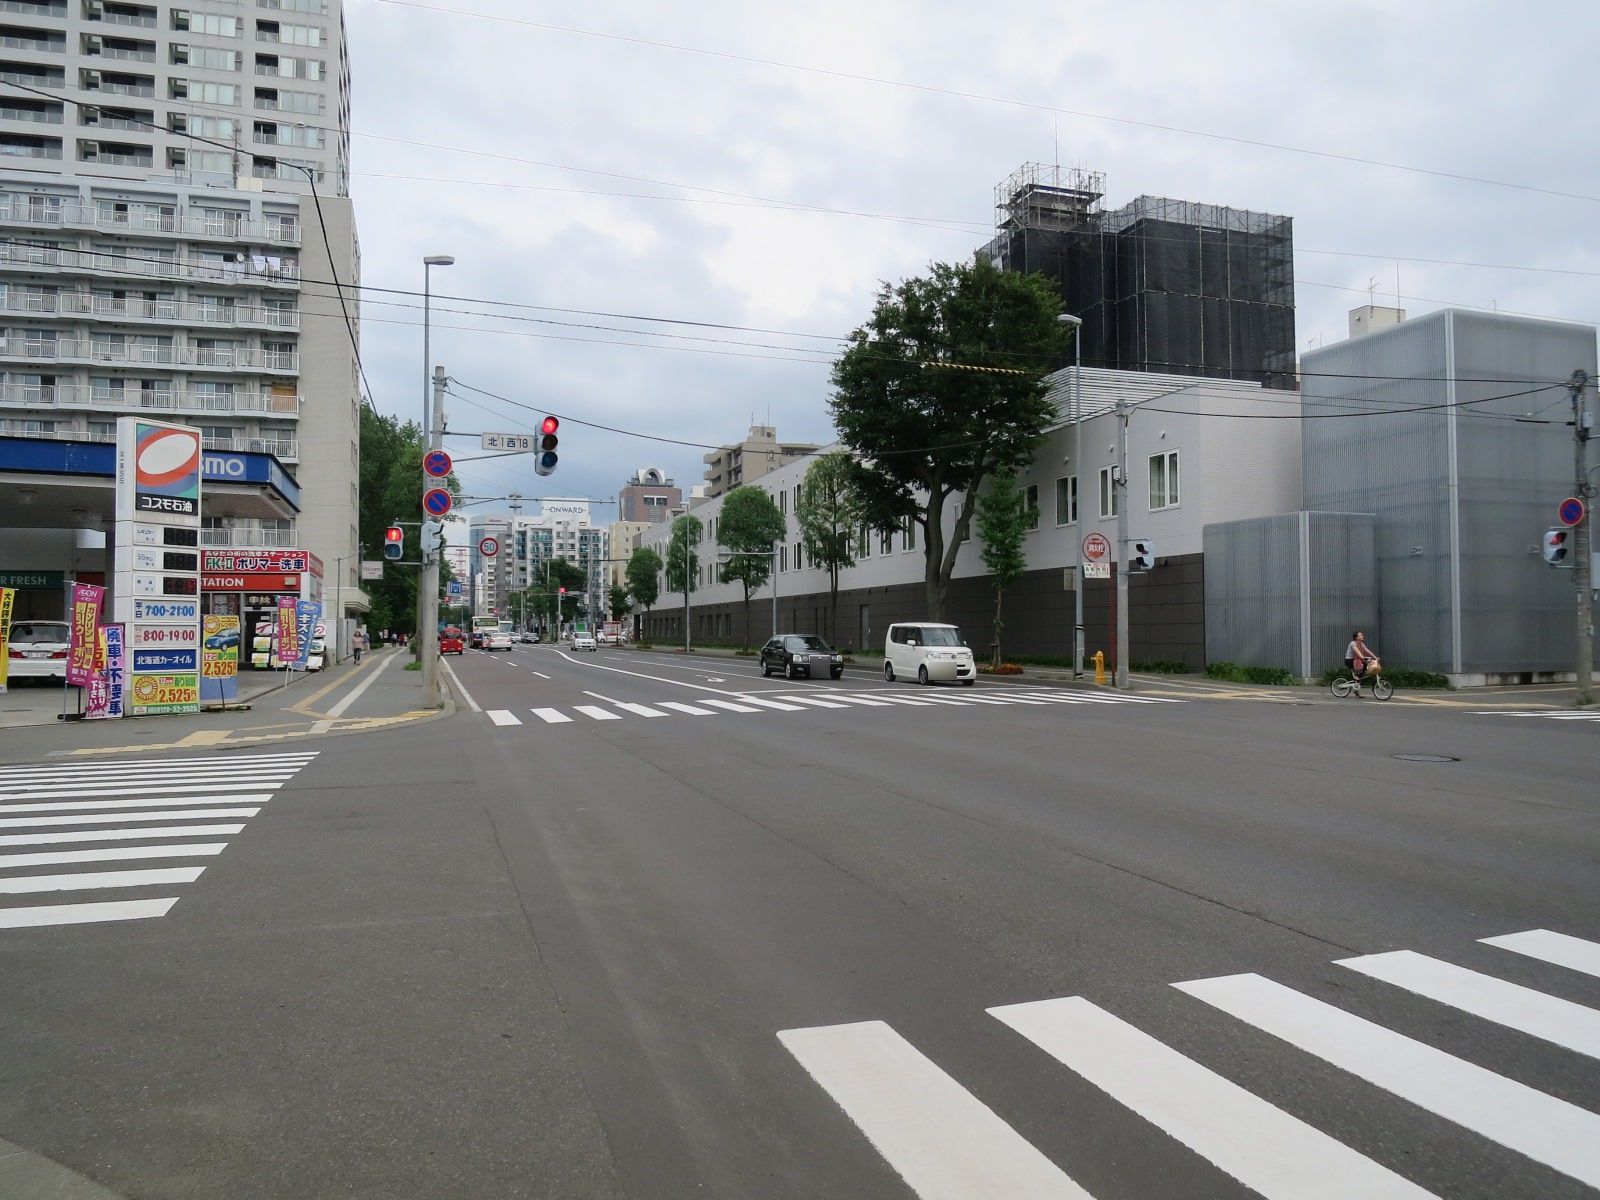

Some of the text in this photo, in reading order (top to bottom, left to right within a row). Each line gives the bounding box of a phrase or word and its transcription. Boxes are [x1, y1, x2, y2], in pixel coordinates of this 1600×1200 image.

[488, 437, 528, 448] 北1西18
[201, 456, 244, 476] mo
[141, 496, 193, 512] コスモ石油
[484, 542, 494, 551] 50
[236, 557, 305, 570] ポリマー洗車
[11, 576, 46, 585] FRESH
[200, 578, 243, 586] TATION
[86, 605, 96, 638] ガソリン
[136, 655, 192, 665] 北海道カーオイル
